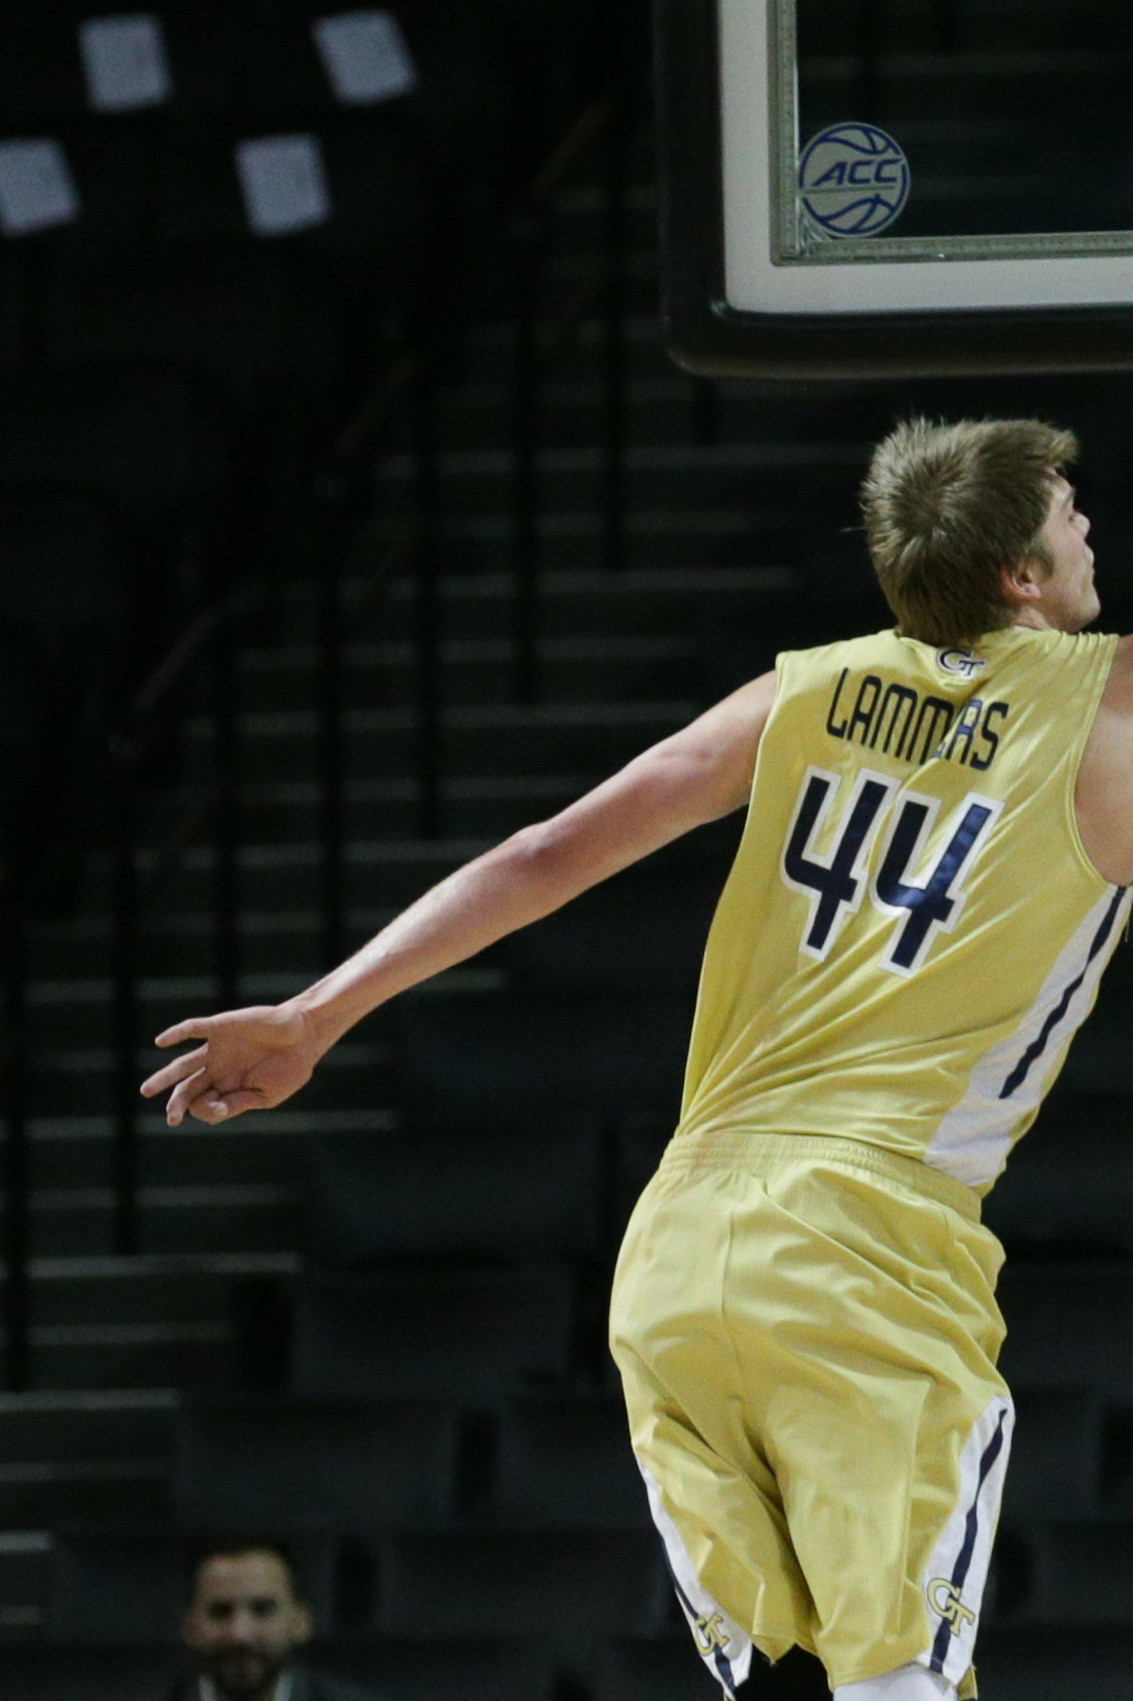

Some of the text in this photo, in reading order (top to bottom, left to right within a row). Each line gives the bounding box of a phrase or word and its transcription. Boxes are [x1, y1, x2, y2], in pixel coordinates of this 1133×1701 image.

[810, 158, 903, 187] ACC
[826, 667, 1009, 771] LAMMAS
[779, 763, 1006, 979] 44
